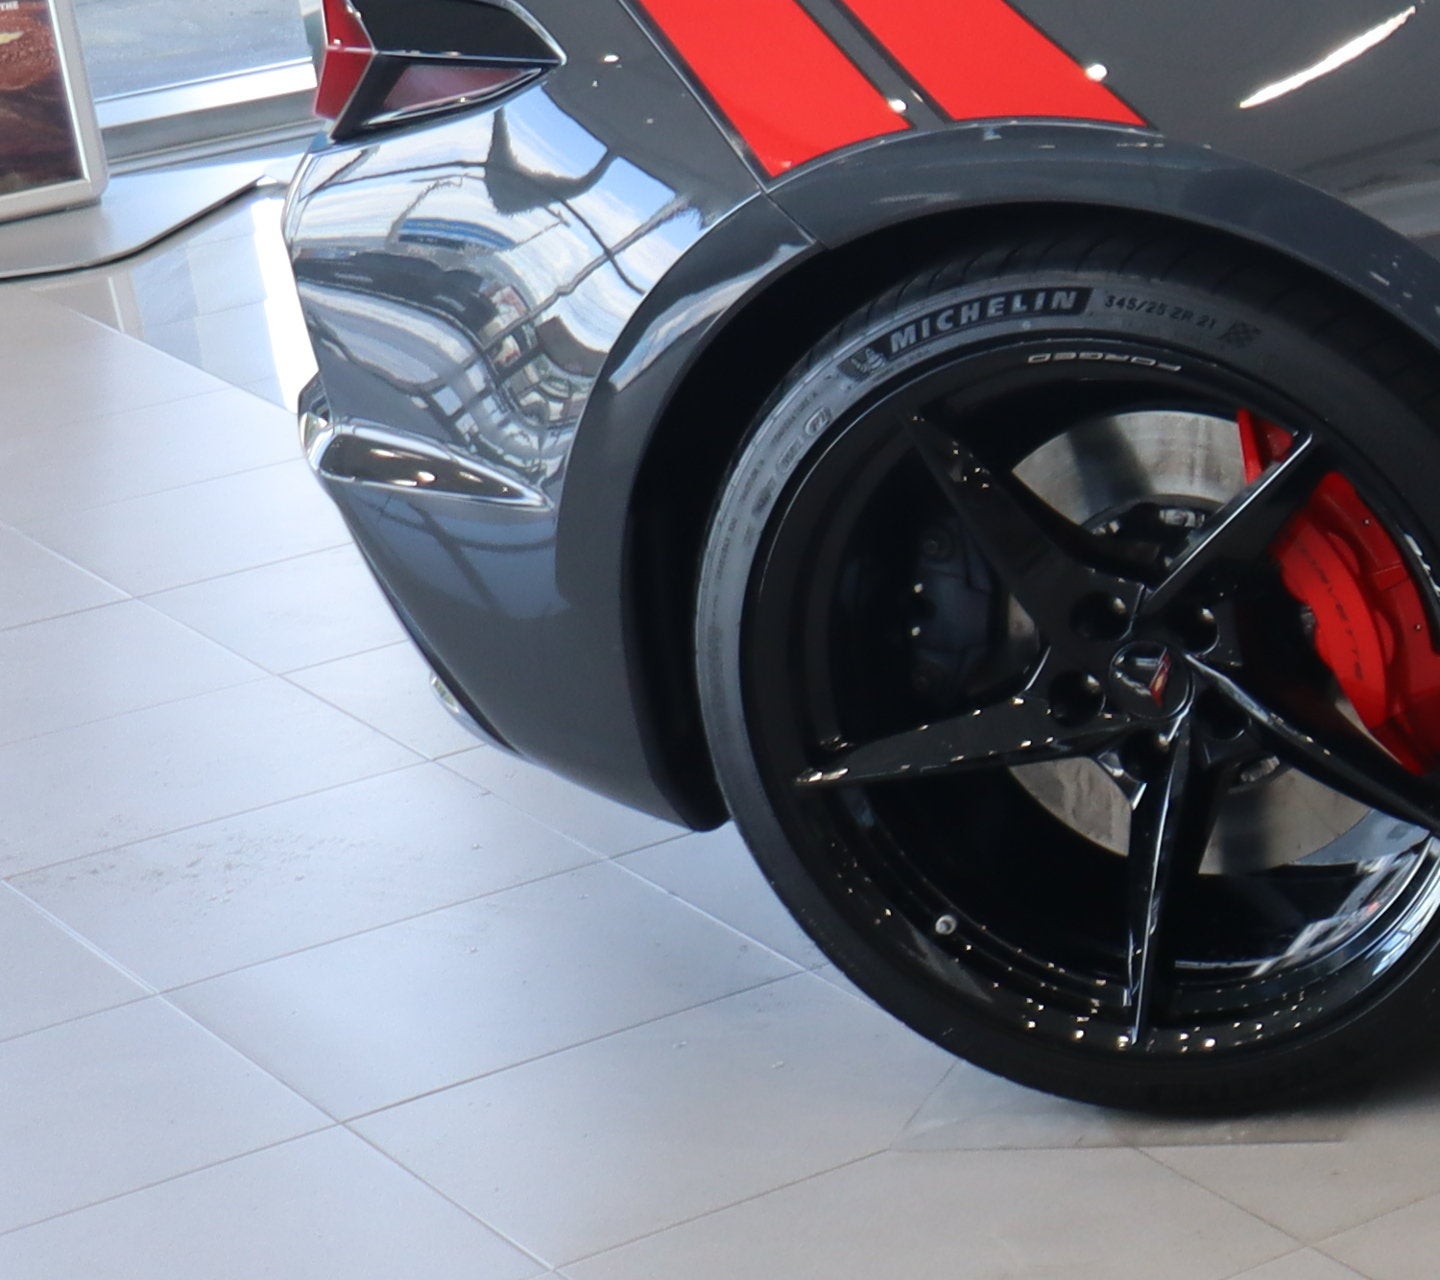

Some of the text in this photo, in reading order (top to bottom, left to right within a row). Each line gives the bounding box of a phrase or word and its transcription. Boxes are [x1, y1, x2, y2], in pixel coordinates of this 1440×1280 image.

[889, 290, 1079, 353] MICHELIN
[1104, 295, 1166, 317] 345/25
[1196, 314, 1216, 330] 21
[1027, 351, 1183, 372] FORGED
